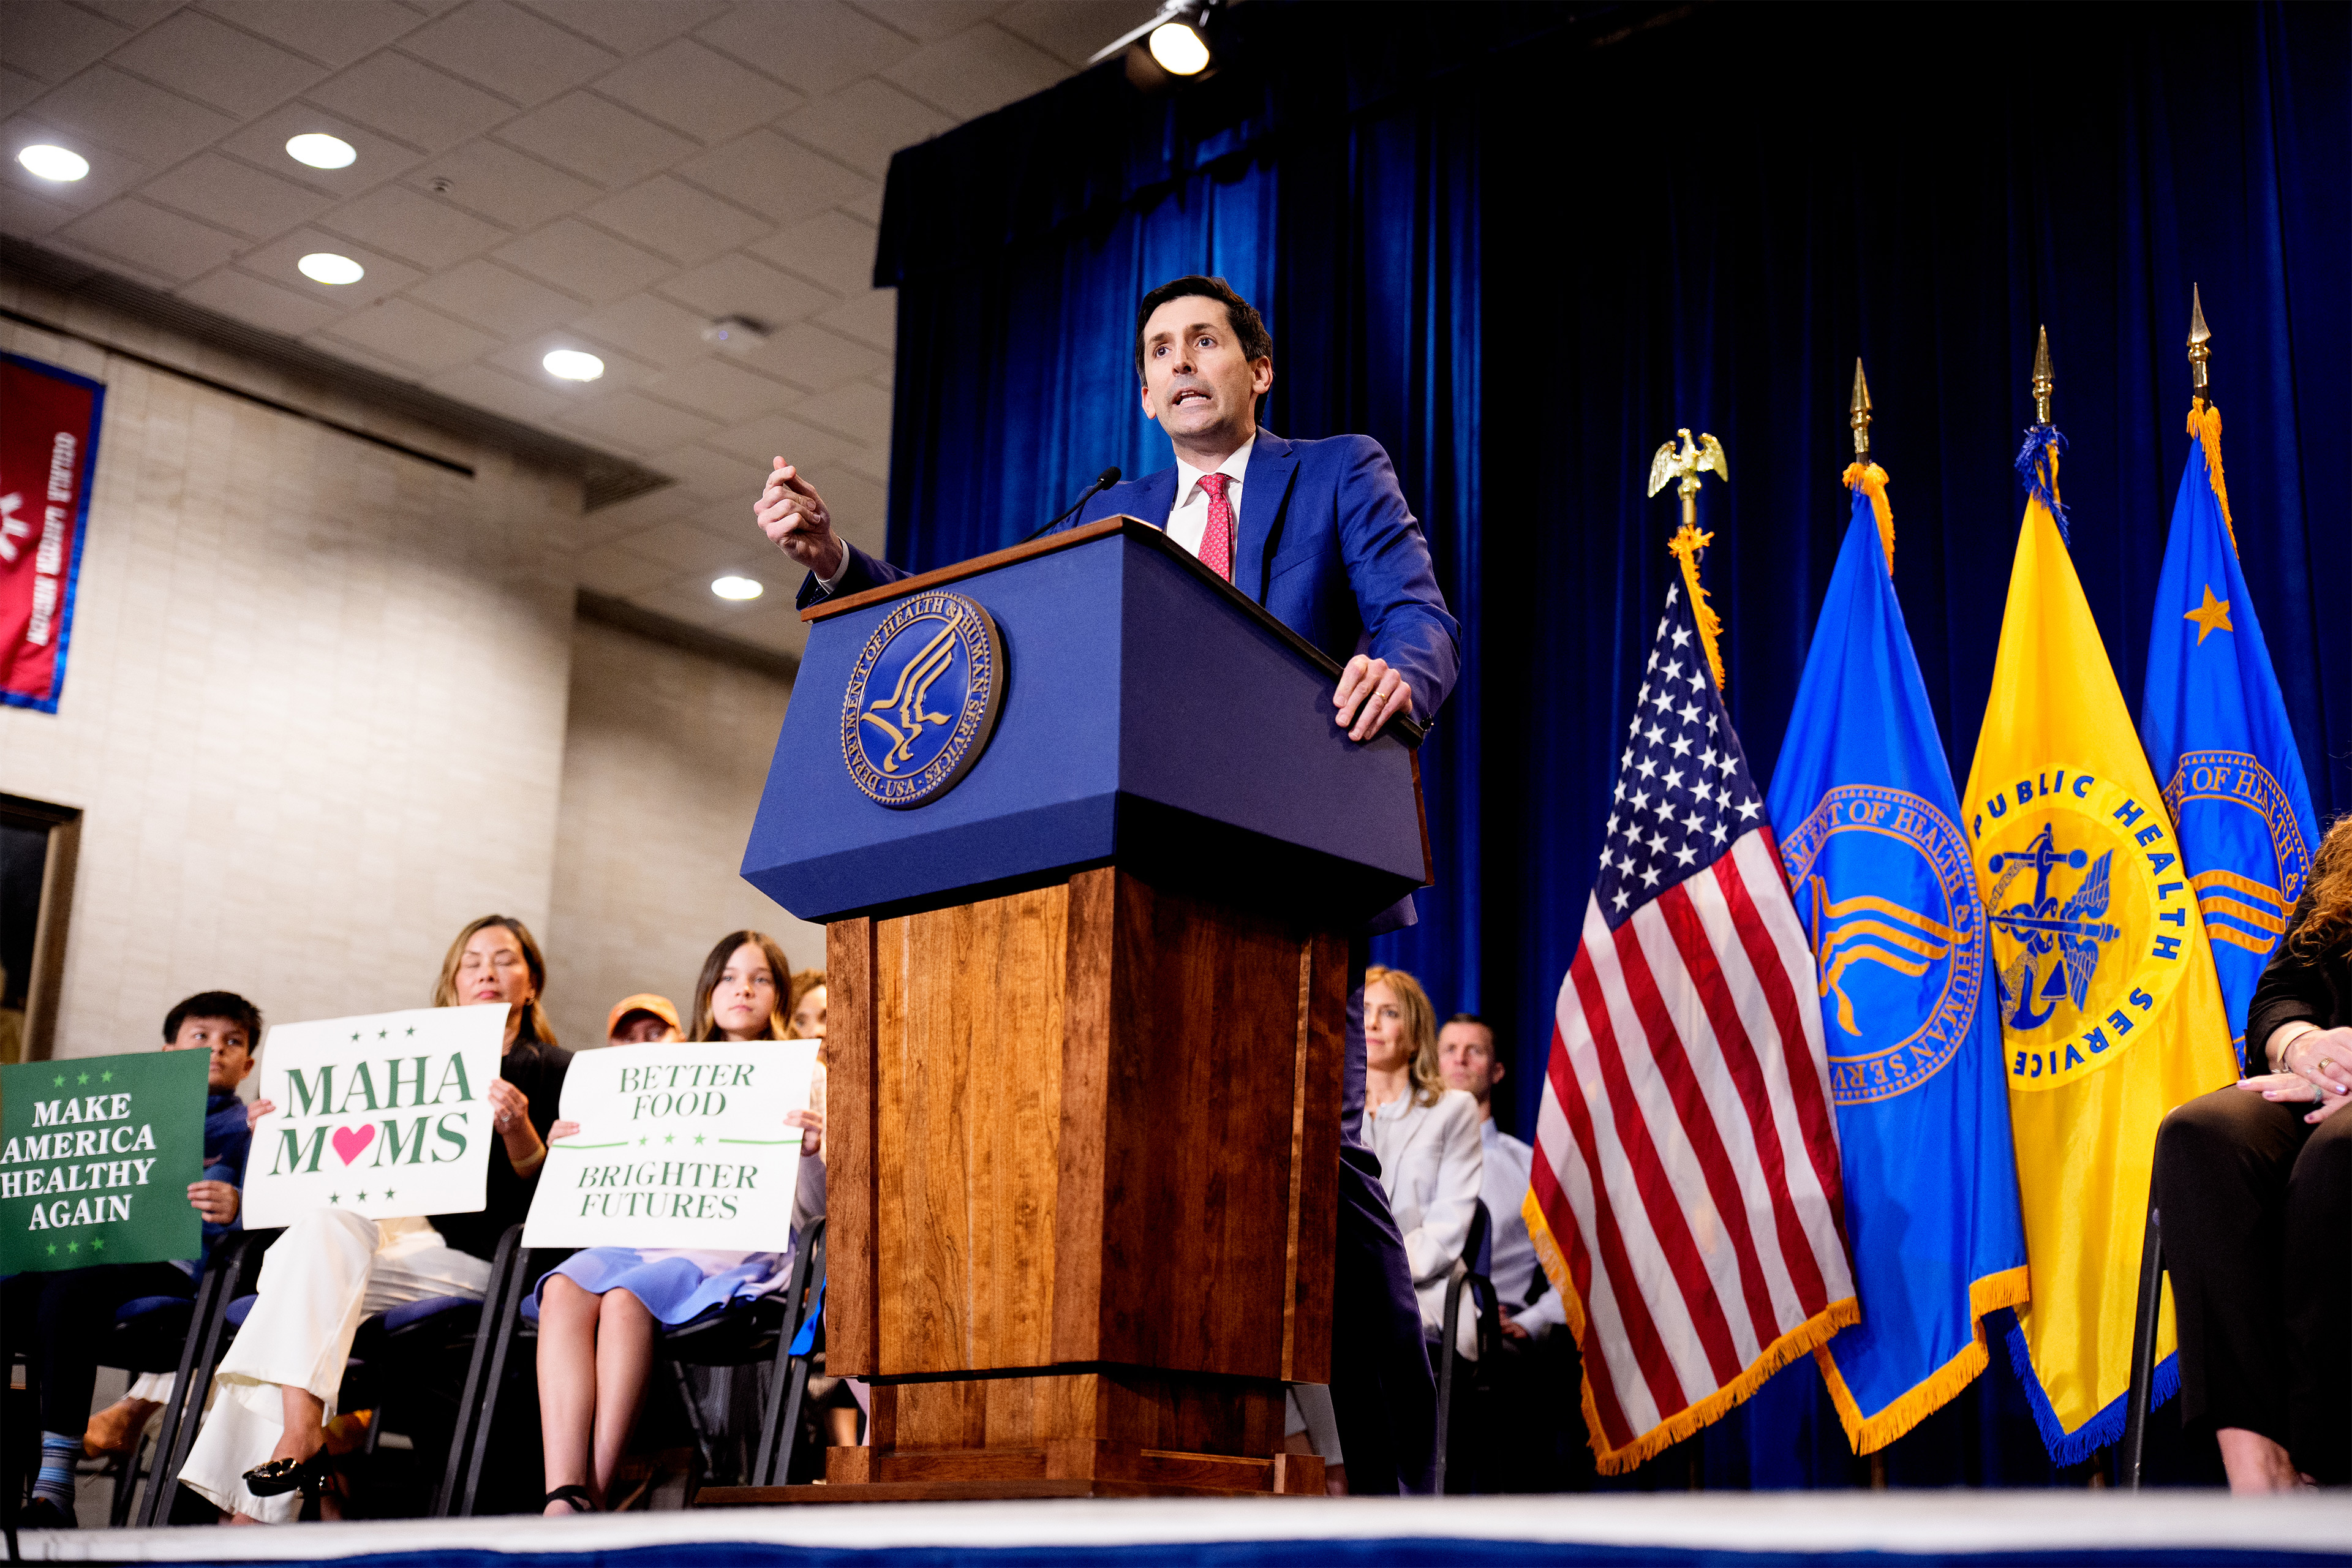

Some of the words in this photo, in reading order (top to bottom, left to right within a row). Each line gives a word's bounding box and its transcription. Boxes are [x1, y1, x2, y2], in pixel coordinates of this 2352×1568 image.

[883, 597, 945, 640] HEALTH
[945, 601, 958, 618] &
[865, 636, 883, 661] OF
[960, 616, 983, 693] HUMAN
[846, 663, 880, 791] DEPARTMENT
[925, 699, 979, 784] SERVICES
[886, 778, 916, 796] USA
[2192, 767, 2231, 791] OF
[1849, 799, 1891, 824] OF
[1973, 771, 2095, 840] PUBLIC
[1891, 809, 1966, 897] HEALTH
[2113, 799, 2185, 960] HEALTH
[1954, 904, 1971, 926] &
[1909, 949, 1974, 1067] HUMAN
[2013, 987, 2154, 1078] SERVICE
[282, 1050, 476, 1119] MAHA
[619, 1063, 755, 1094] BETTER
[1830, 1054, 1907, 1089] SERV
[32, 1093, 132, 1128] MAKE
[632, 1091, 727, 1121] FOOD
[1, 1125, 156, 1164] AMERICA
[0, 1158, 157, 1199] HEALTHY
[577, 1161, 760, 1190] BRIGHTER
[28, 1194, 132, 1231] AGAIN
[579, 1192, 739, 1221] FUTURES
